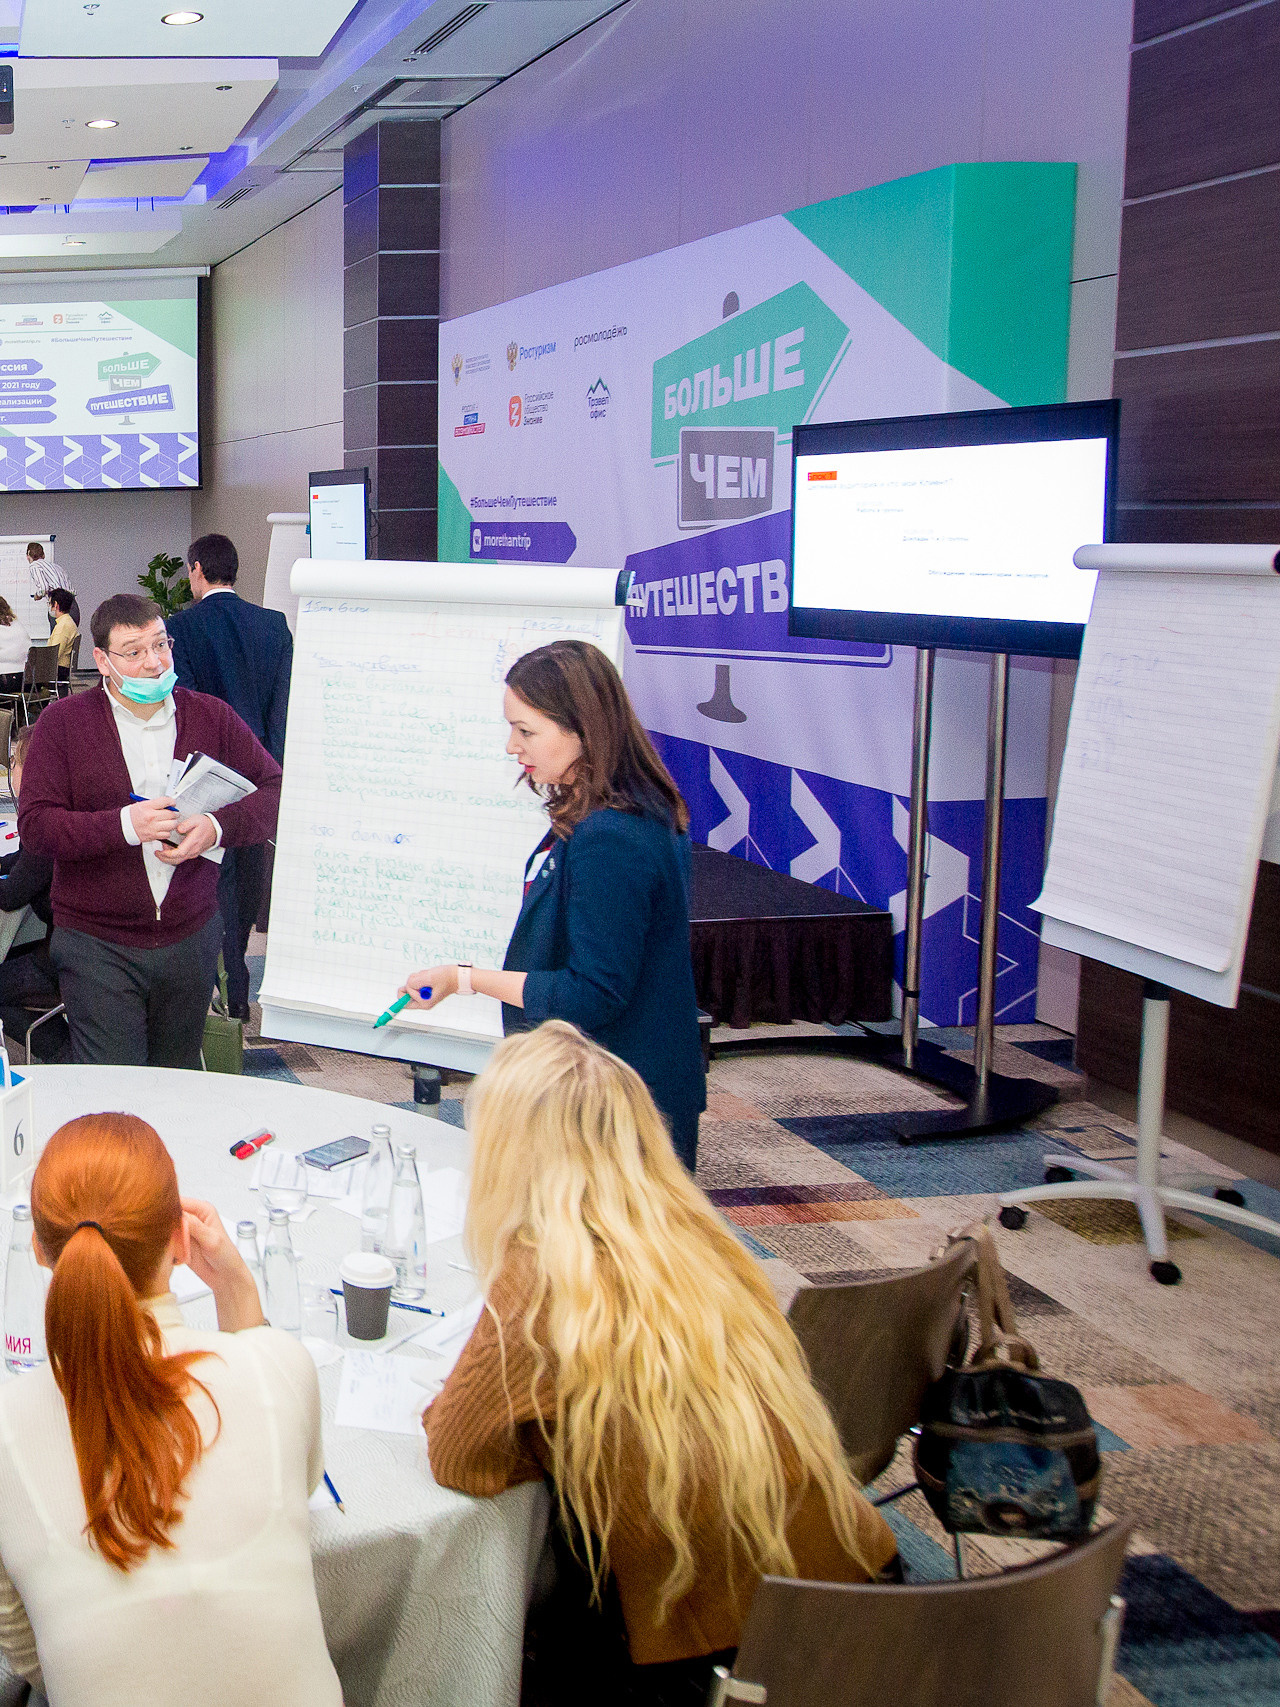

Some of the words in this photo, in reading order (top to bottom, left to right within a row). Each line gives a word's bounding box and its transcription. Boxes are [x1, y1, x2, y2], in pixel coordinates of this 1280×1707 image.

[573, 325, 628, 352] росмолодёжь
[519, 341, 557, 360] Ростуризм
[102, 359, 150, 373] БОЛЬШЕ
[664, 326, 805, 420] БОЛЬШЕ
[21, 381, 41, 390] году
[112, 378, 140, 387] ЧЕМ
[90, 392, 169, 411] ПУТЕШЕСТВИЕ
[523, 415, 543, 426] Знание
[590, 408, 607, 419] офис
[689, 453, 767, 499] ЧЕМ
[484, 532, 531, 551] morethantrip
[627, 559, 789, 618] ПУТЕШЕСТВ
[14, 1119, 24, 1156] 6
